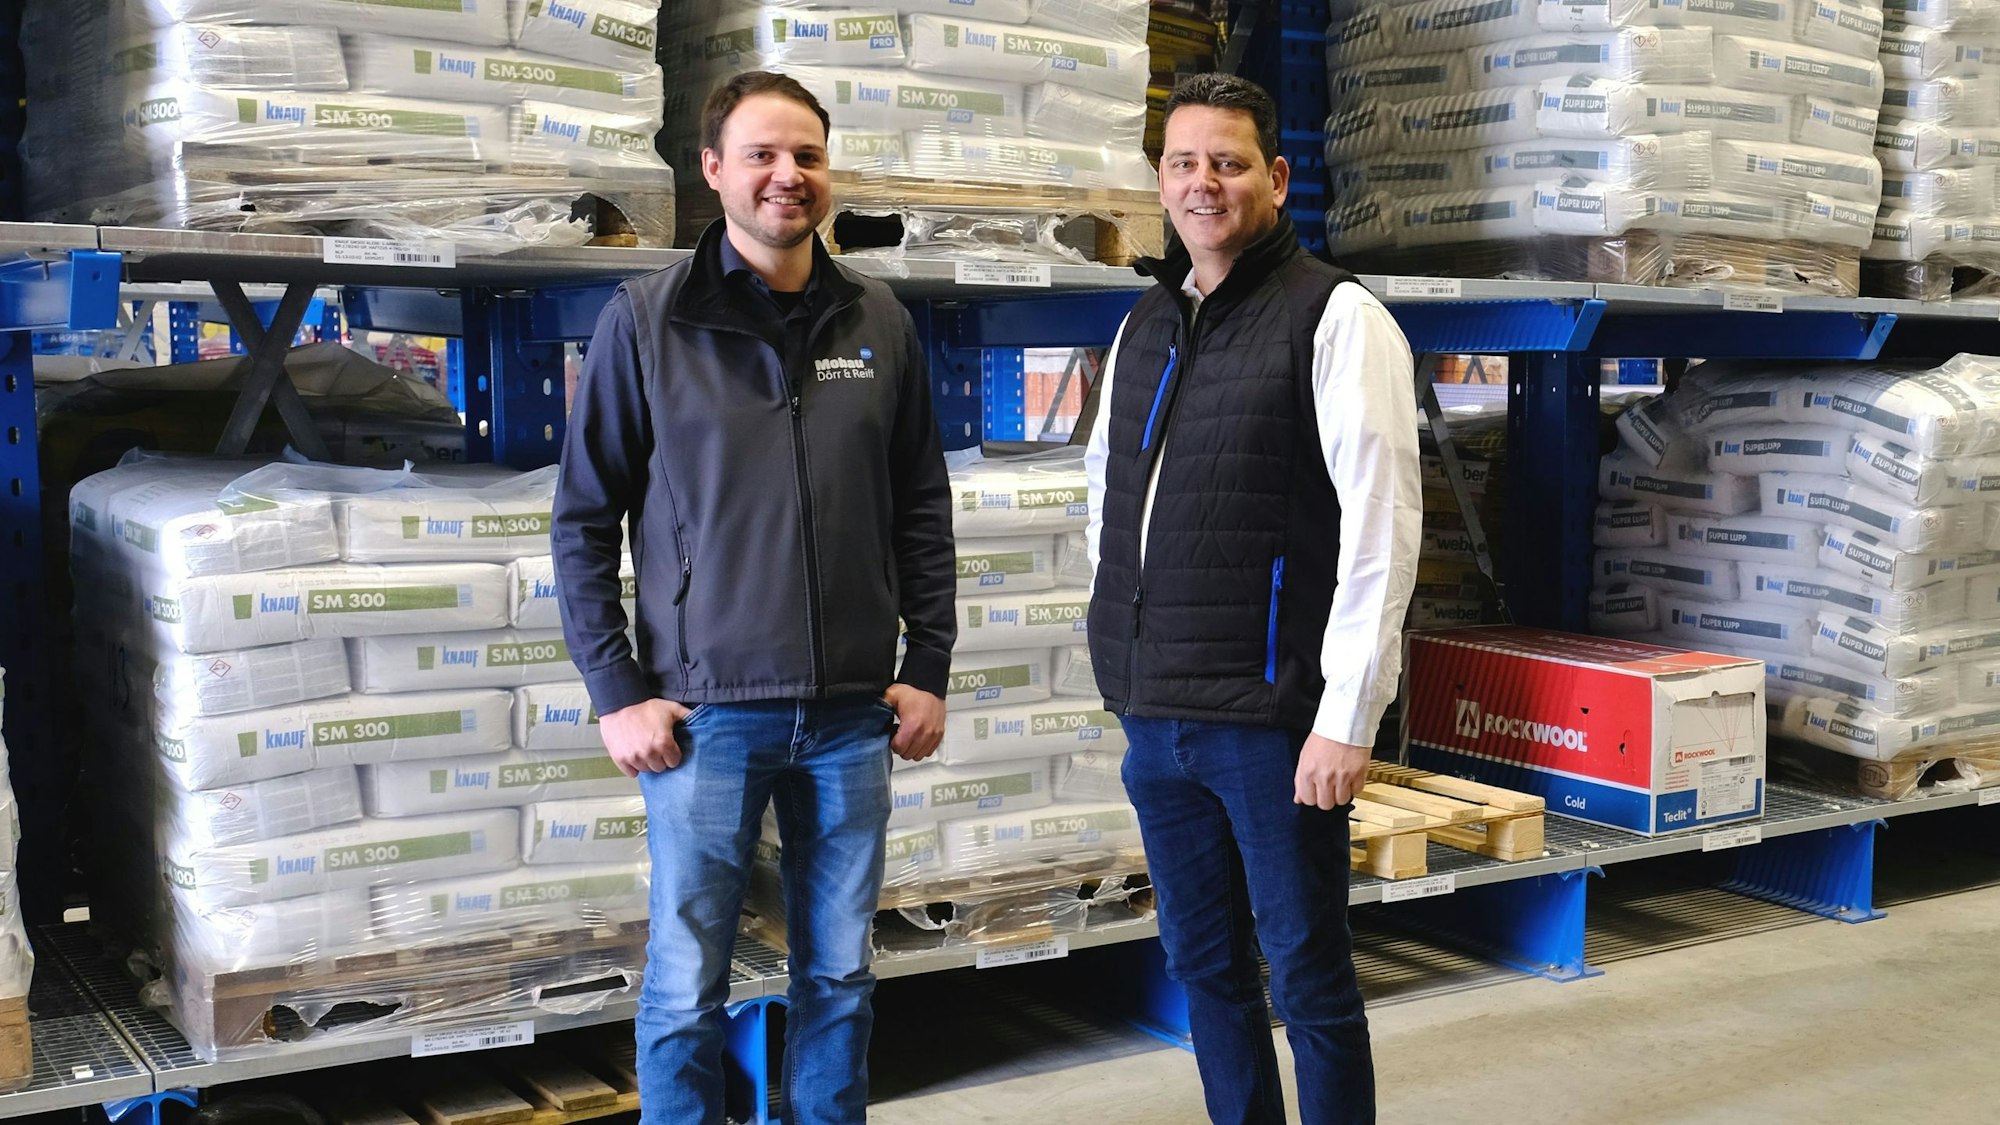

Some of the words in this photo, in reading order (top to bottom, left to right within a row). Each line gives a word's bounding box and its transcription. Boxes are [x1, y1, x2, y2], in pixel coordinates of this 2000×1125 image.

[548, 2, 587, 29] KNAUF
[1840, 13, 1862, 29] SUPER
[794, 19, 829, 42] KNAUF
[839, 21, 864, 36] SM
[867, 20, 895, 35] 700
[872, 37, 893, 47] PRO
[965, 27, 998, 50] KNAUF
[1007, 38, 1031, 52] SM
[1035, 41, 1063, 55] 700
[439, 53, 477, 78] KNAUF
[489, 62, 516, 77] SM
[521, 65, 557, 82] 300
[1054, 58, 1074, 70] PRO
[1786, 60, 1811, 72] SUPER
[858, 82, 892, 104] KNAUF
[902, 90, 925, 104] SM
[929, 92, 959, 107] 700
[265, 100, 307, 124] KNAUF
[320, 109, 351, 125] SM
[356, 111, 393, 128] 300
[950, 111, 971, 122] PRO
[1686, 103, 1711, 115] SUPER
[542, 114, 582, 142] KNAUF
[1834, 115, 1857, 128] SUPER
[845, 138, 870, 151] SM
[872, 139, 900, 151] 700
[1558, 197, 1581, 209] SUPER
[1834, 208, 1858, 222] SUPER
[814, 357, 865, 371] Mobau
[817, 369, 842, 382] Dörr
[844, 369, 852, 379] &
[853, 368, 875, 379] Reiff
[1440, 463, 1487, 482] wber
[1021, 493, 1044, 506] SM
[1047, 490, 1075, 504] 700
[1068, 505, 1088, 515] PRO
[427, 516, 464, 538] KNAUF
[477, 519, 504, 534] SM
[507, 516, 541, 533] 300
[1827, 534, 1845, 554] KNAUF
[1848, 546, 1871, 564] SUPER
[1871, 557, 1891, 571] LUPP
[962, 559, 990, 574] 700
[983, 575, 1001, 584] PRO
[534, 579, 558, 599] KNA
[1788, 584, 1811, 596] SUPER
[260, 592, 299, 615] KNAUF
[313, 594, 344, 609] SM
[348, 593, 386, 608] 300
[988, 605, 1020, 626] KNAUF
[1029, 608, 1052, 621] SM
[1055, 606, 1082, 620] 700
[1433, 604, 1480, 621] weber
[1702, 617, 1723, 628] SUPER
[1723, 619, 1740, 630] LUPP
[1819, 625, 1838, 642] KNAUF
[1840, 635, 1864, 650] SUPER
[1864, 645, 1884, 659] LUPP
[442, 645, 479, 668] KNAUF
[491, 648, 520, 662] SM
[523, 645, 557, 661] 300
[958, 673, 987, 688] 700
[1782, 668, 1805, 681] SUPER
[979, 689, 998, 699] PRO
[544, 704, 582, 726] KNAUF
[994, 717, 1025, 737] KNAUF
[1034, 718, 1058, 730] SM
[1060, 714, 1088, 728] 700
[1081, 729, 1099, 739] PRO
[1485, 713, 1588, 753] ROCKWOOL
[1831, 723, 1854, 737] SUPER
[1854, 729, 1874, 741] LUPP
[265, 729, 306, 750] KNAUF
[318, 725, 349, 742] SM
[353, 721, 390, 739] 300
[1684, 748, 1716, 760] ROCKWOOL
[454, 768, 491, 790] KNAUF
[503, 770, 531, 783] SM
[535, 764, 569, 780] 300
[894, 791, 925, 809] KNAUF
[934, 785, 958, 802] SM
[961, 782, 990, 797] 700
[981, 797, 1001, 808] PRO
[1565, 795, 1586, 810] Cold
[550, 820, 588, 842] KNAUF
[600, 821, 627, 835] SM
[994, 824, 1025, 842] KNAUF
[1035, 822, 1057, 837] SM
[1061, 818, 1088, 831] 700
[909, 834, 935, 852] 700
[276, 855, 316, 876] KNAUF
[329, 851, 359, 868] SM
[363, 845, 400, 862] 300
